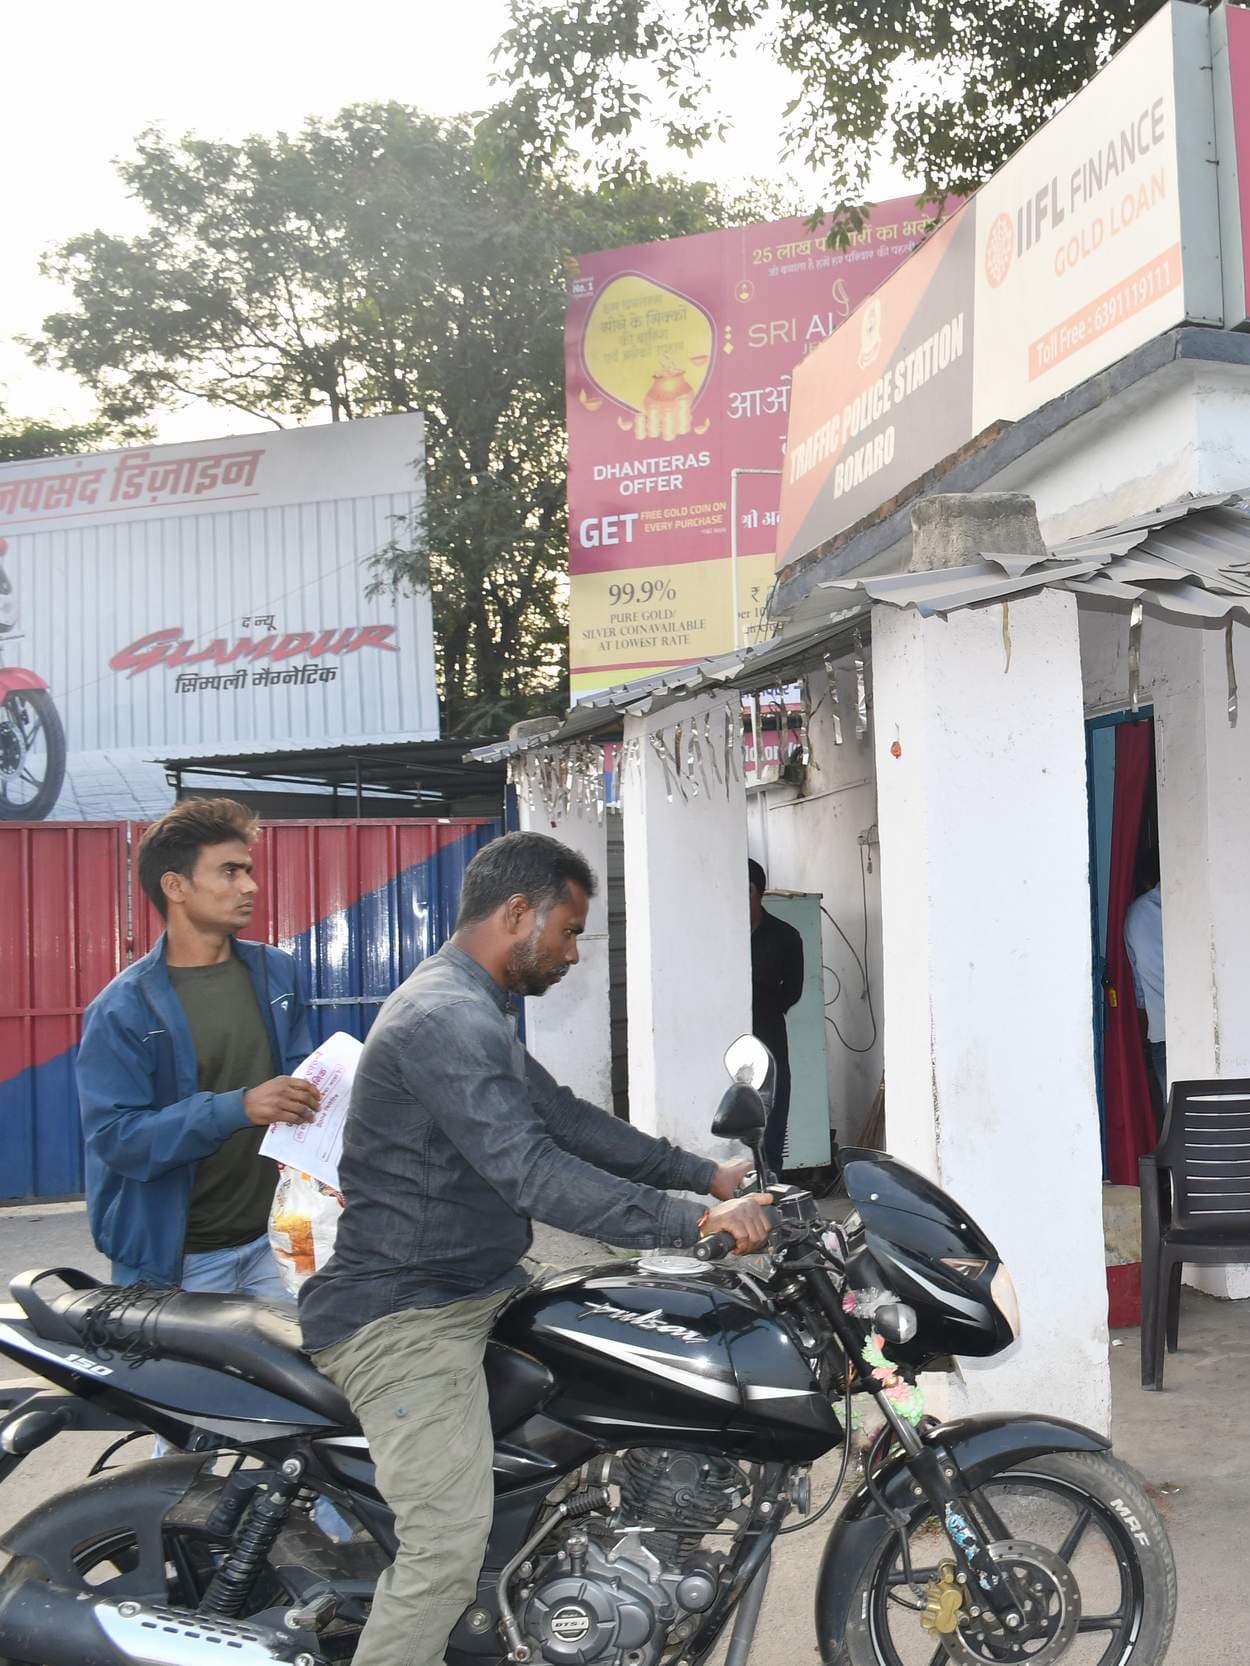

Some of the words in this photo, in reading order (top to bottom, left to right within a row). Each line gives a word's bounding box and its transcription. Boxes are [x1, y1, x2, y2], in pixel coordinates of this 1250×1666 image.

[1017, 175, 1065, 259] IIFL
[1070, 96, 1166, 214] FINANCE
[1054, 217, 1105, 279] GOLD
[1110, 167, 1167, 236] LOAN
[752, 247, 773, 265] 25
[776, 240, 811, 261] लाख
[876, 223, 898, 241] का
[1036, 332, 1057, 369] Toll
[1059, 320, 1086, 353] Free
[1094, 261, 1171, 331] 6391119111
[748, 318, 797, 348] SRI
[789, 414, 840, 485] TRAFFIC
[841, 370, 893, 445] POLICE
[894, 312, 964, 404] STATION
[110, 449, 265, 503] डिज़ाइन
[593, 451, 711, 481] DHANTERAS
[833, 425, 895, 500] BOKARO
[619, 474, 683, 496] OFFER
[579, 512, 639, 548] GET
[640, 509, 662, 521] FREE
[663, 506, 688, 519] GOLD
[689, 503, 710, 516] COIN
[712, 501, 727, 513] ON
[644, 521, 672, 533] EVERY
[674, 514, 723, 530] PURCHASE
[608, 578, 677, 606] 99.9%
[241, 615, 250, 628] द
[610, 610, 639, 624] PURE
[582, 627, 617, 640] SILVER
[599, 641, 611, 652] AT
[615, 636, 657, 649] LOWEST
[662, 634, 690, 646] RATE
[108, 624, 400, 680] GLAMOUR
[175, 669, 248, 693] सिम्पली
[252, 663, 338, 688] मैग्नेटिक
[63, 1354, 114, 1376] 150
[1110, 1498, 1150, 1546] MRF
